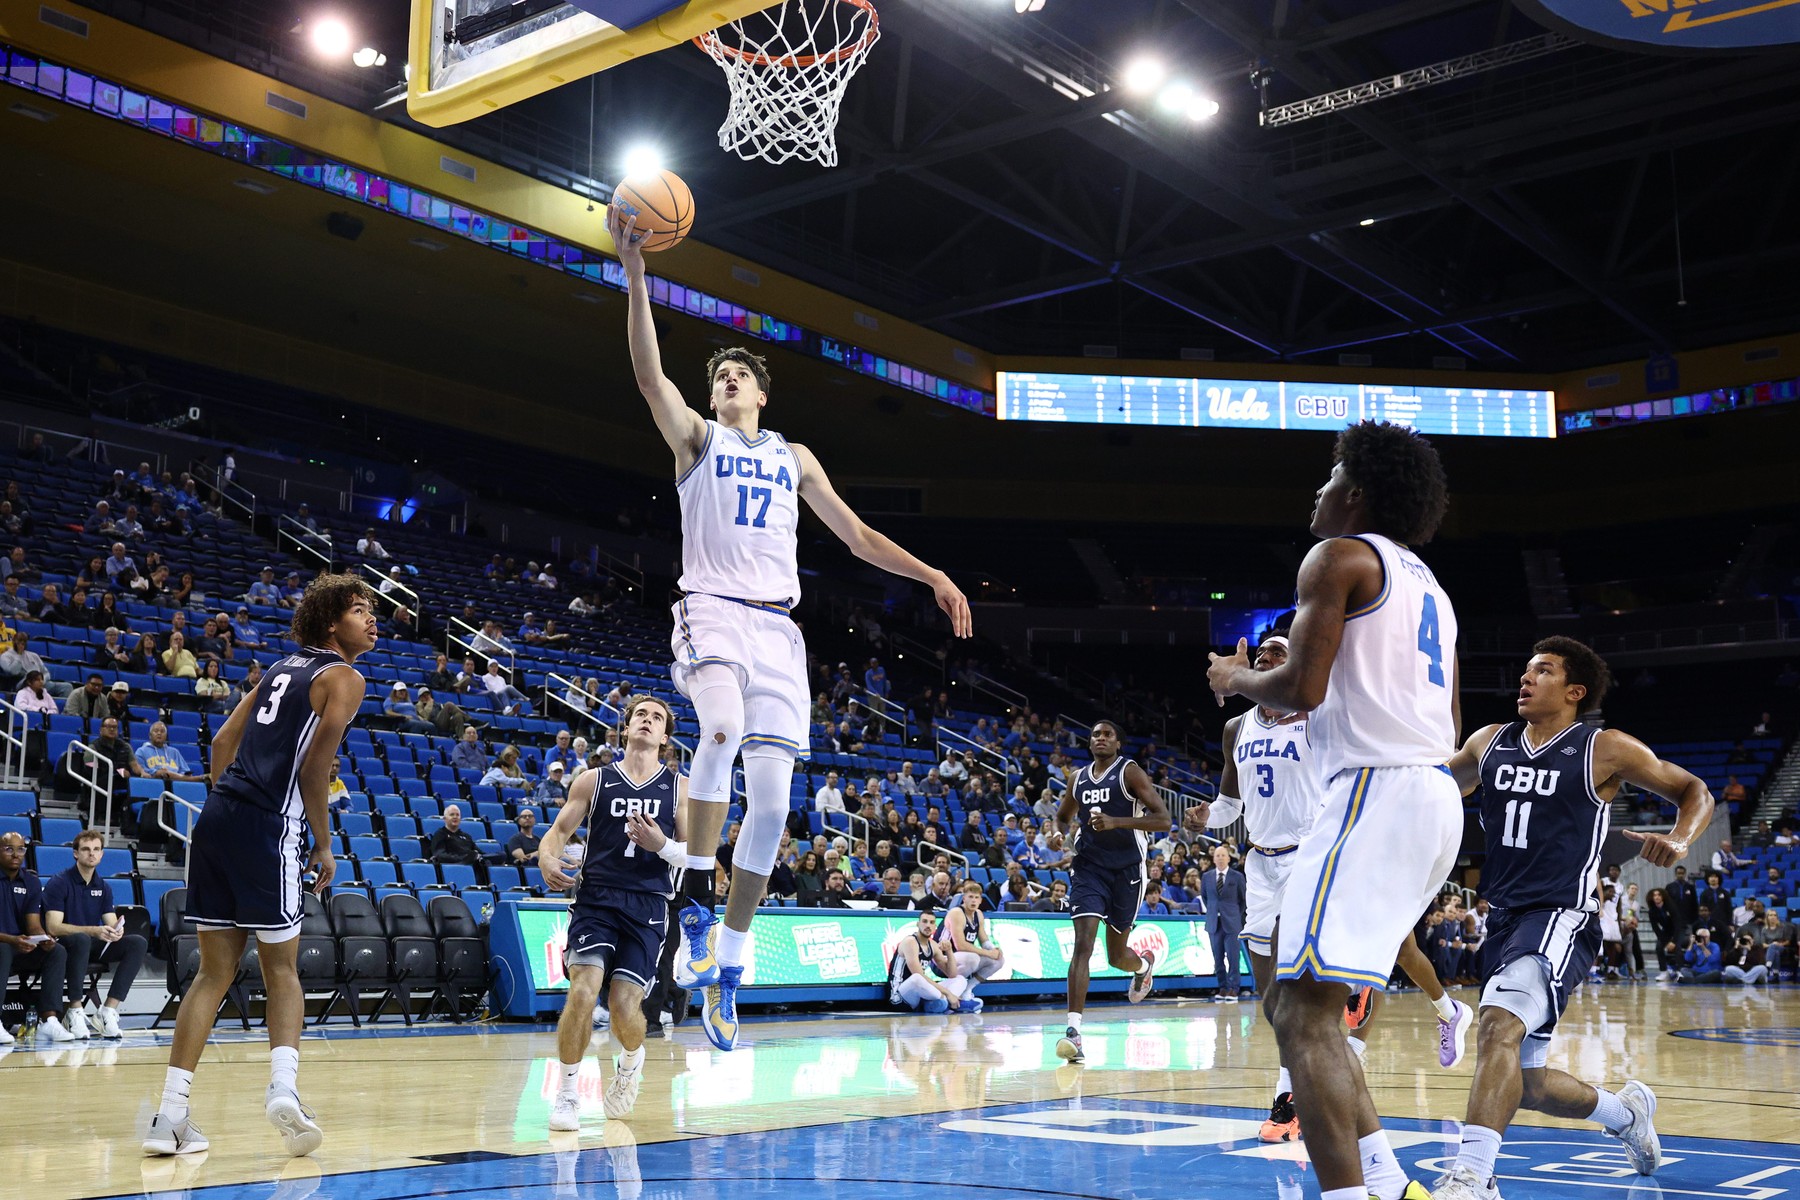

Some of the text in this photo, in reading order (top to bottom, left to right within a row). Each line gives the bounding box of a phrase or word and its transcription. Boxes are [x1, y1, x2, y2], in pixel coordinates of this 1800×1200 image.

[1206, 387, 1271, 420] Ucla
[1296, 397, 1348, 418] CBU
[716, 454, 793, 492] UCLA
[735, 484, 772, 528] 17
[1418, 591, 1446, 689] 4
[256, 673, 292, 725] 3
[147, 755, 179, 769] UCLA
[1238, 739, 1301, 763] UCLA
[1256, 764, 1275, 798] 3
[1494, 764, 1560, 797] CBU
[610, 797, 662, 818] CBU
[1082, 787, 1110, 805] CBU
[1502, 799, 1533, 850] 11
[794, 925, 841, 945] WHERE
[800, 941, 857, 962] LEGENDS
[2, 1002, 24, 1011] ealth
